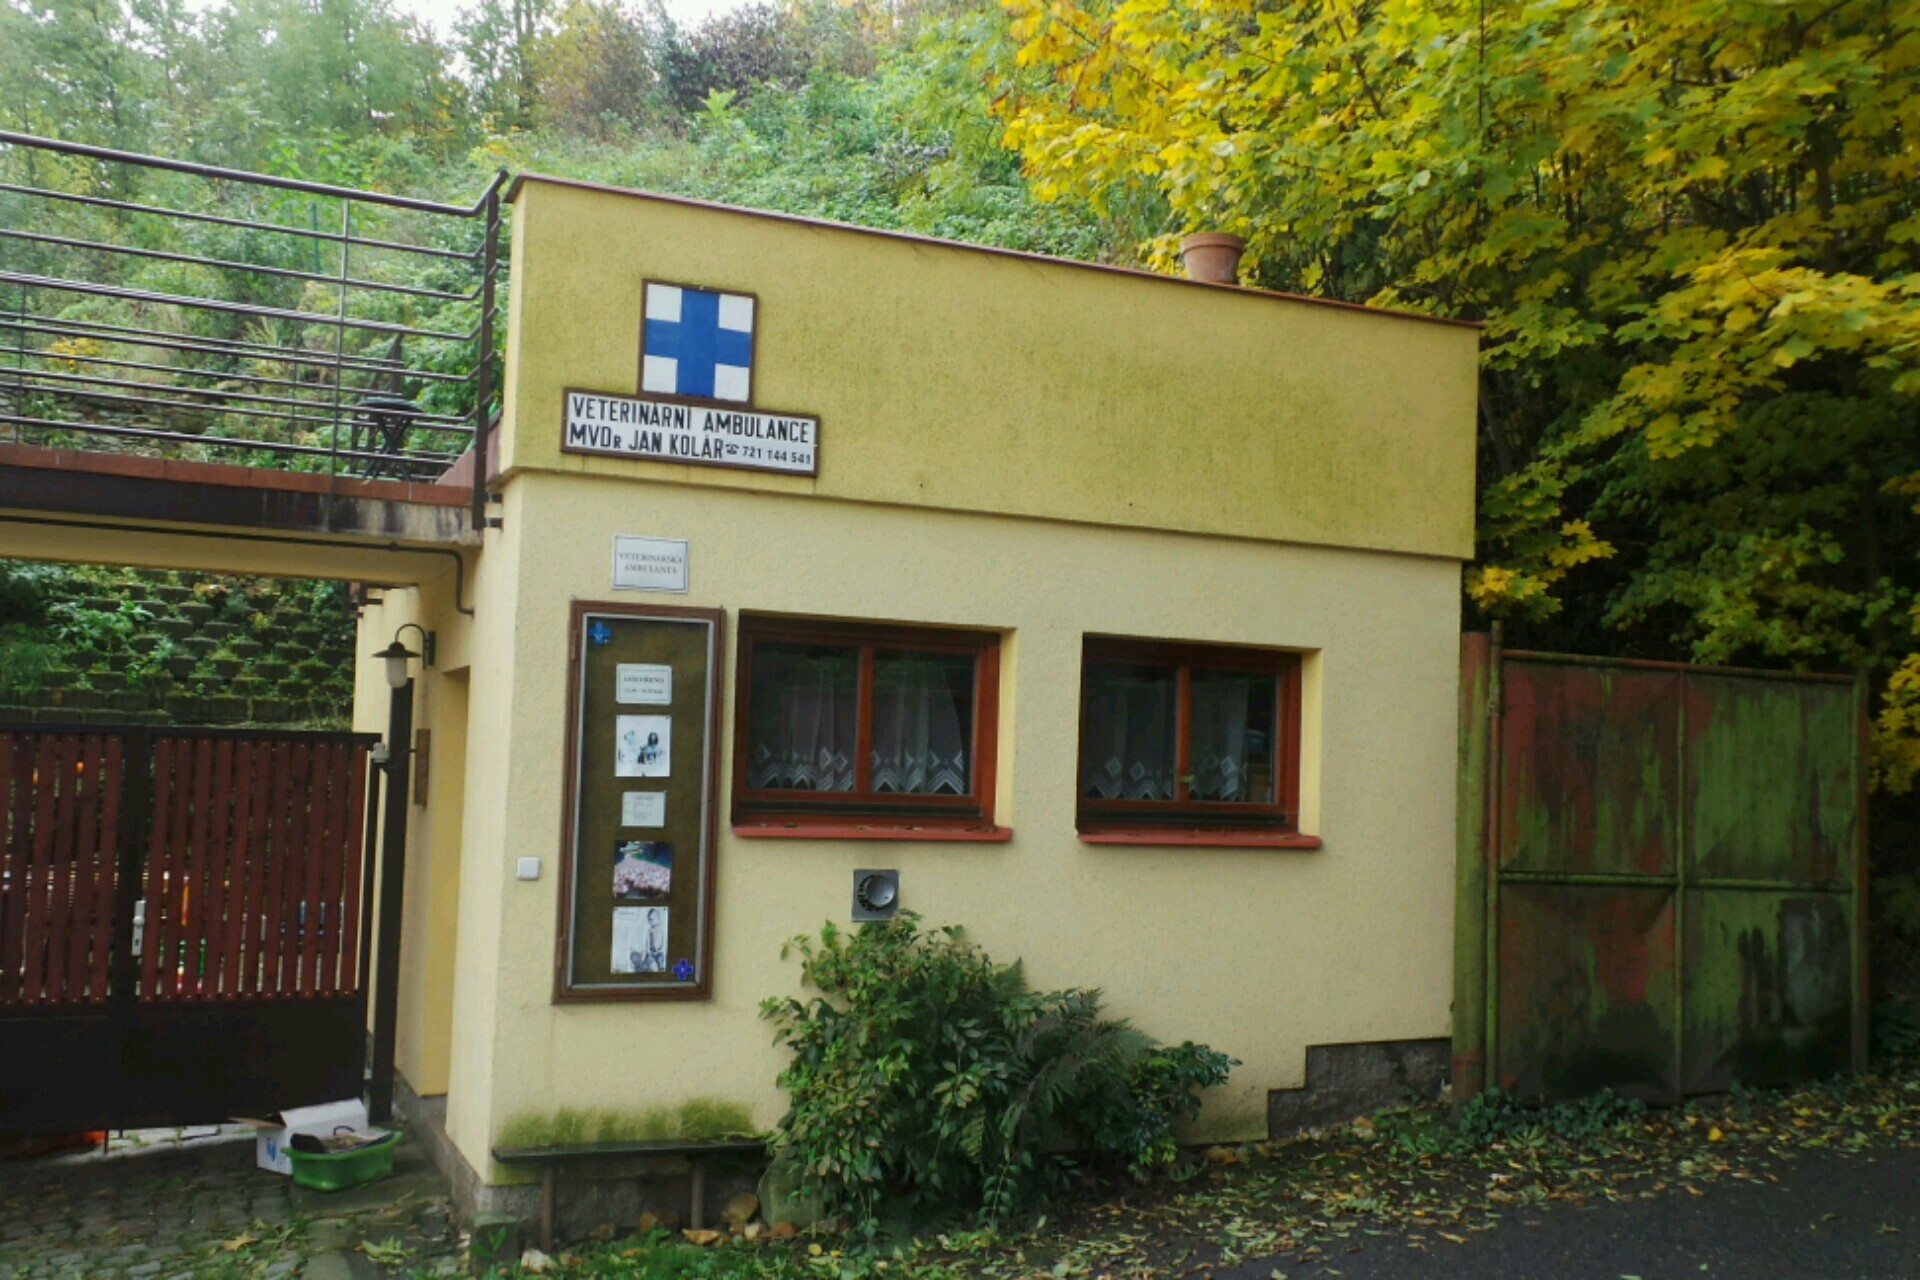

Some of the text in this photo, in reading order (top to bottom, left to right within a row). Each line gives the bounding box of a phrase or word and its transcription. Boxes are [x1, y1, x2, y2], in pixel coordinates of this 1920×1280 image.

[703, 411, 810, 444] AMBULANCE
[628, 430, 662, 454] JAN
[742, 446, 762, 460] 721
[767, 448, 788, 463] 144
